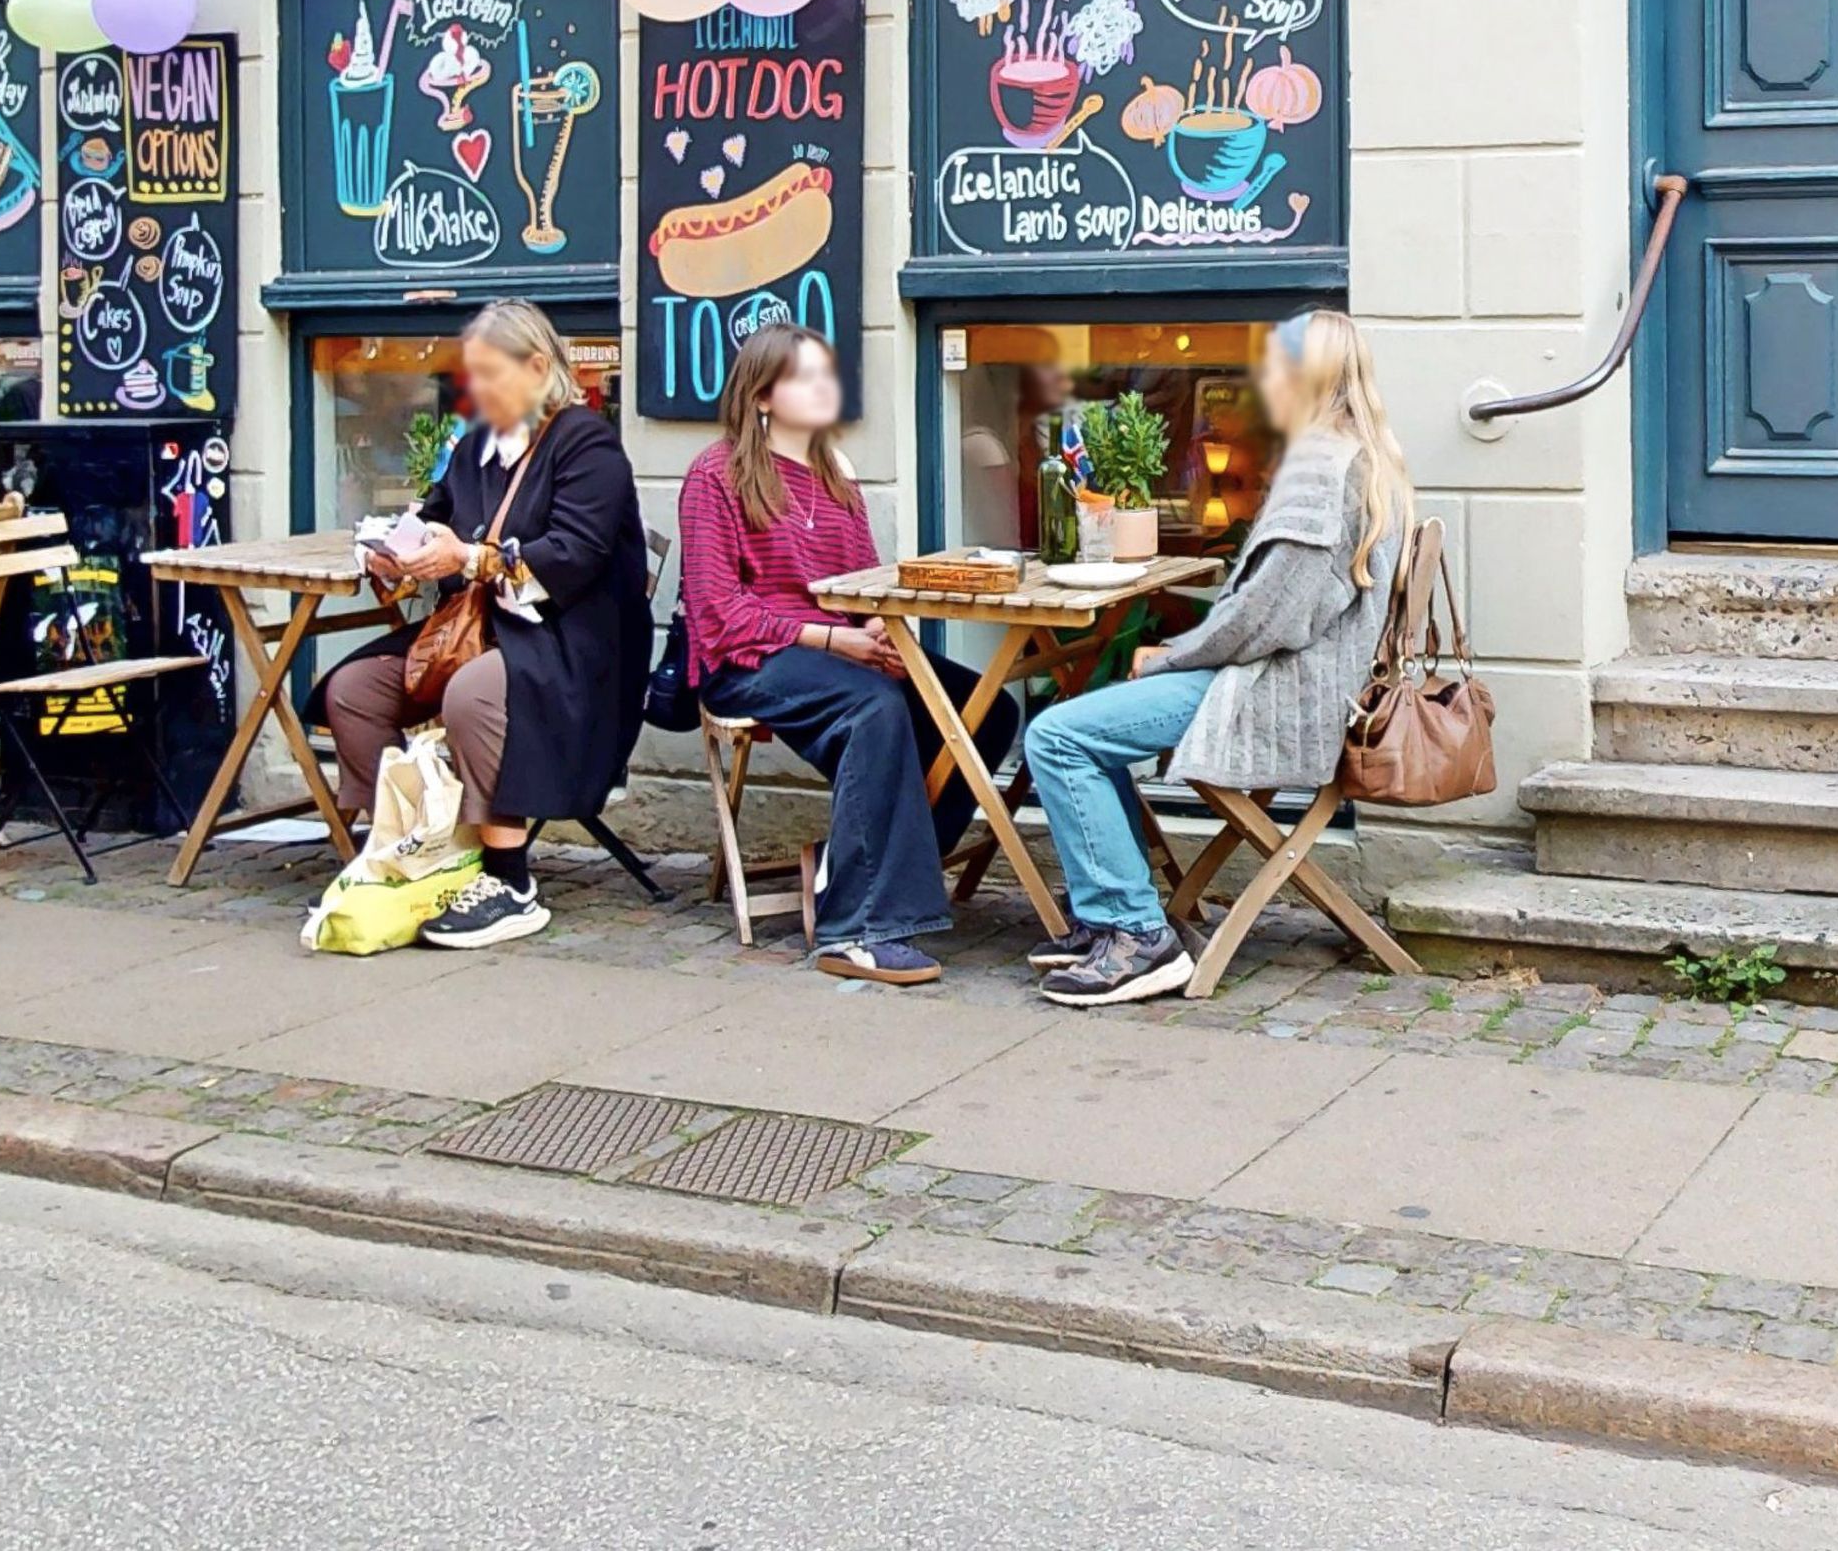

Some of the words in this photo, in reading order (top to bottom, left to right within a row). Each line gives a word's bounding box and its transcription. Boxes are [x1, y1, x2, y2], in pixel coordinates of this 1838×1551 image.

[127, 50, 219, 122] VEGAN
[653, 58, 748, 121] HOT
[746, 57, 844, 122] DOG
[949, 154, 1081, 205] Icelandic
[1003, 202, 1067, 242] Lamb
[1141, 194, 1262, 233] Delicious
[83, 293, 132, 340] Cakes
[652, 297, 725, 402] TO
